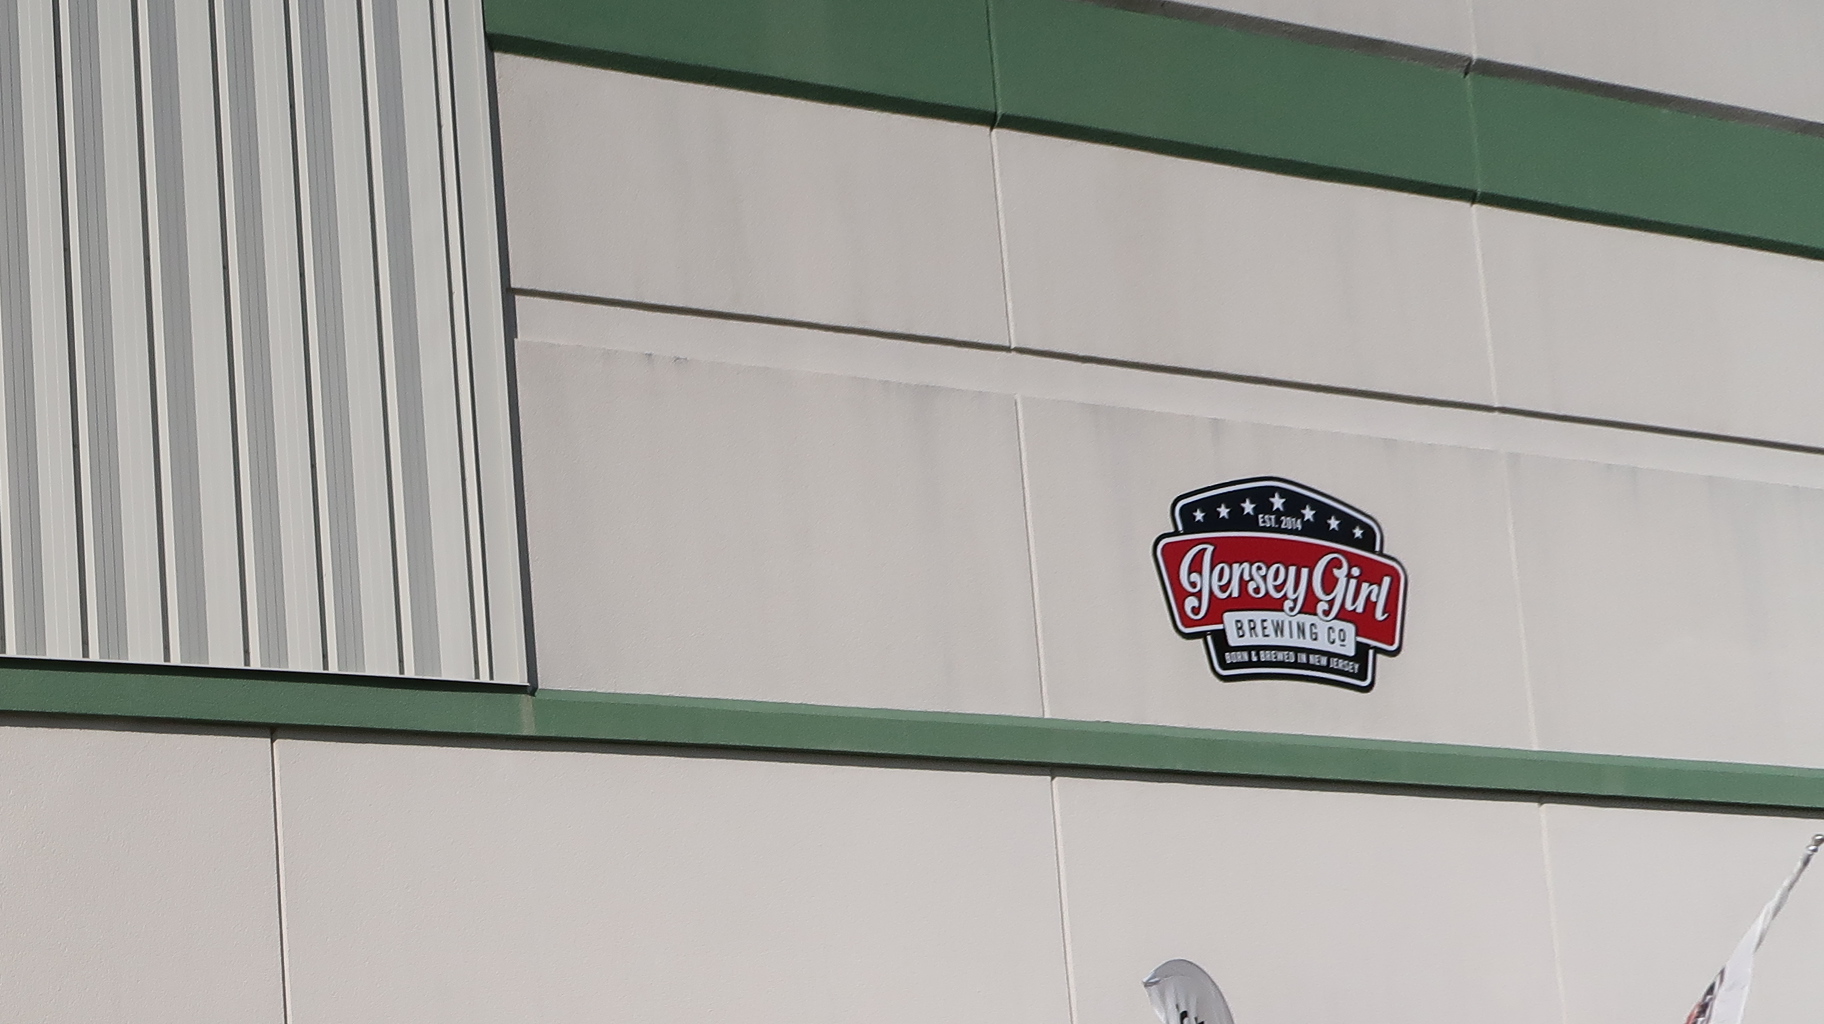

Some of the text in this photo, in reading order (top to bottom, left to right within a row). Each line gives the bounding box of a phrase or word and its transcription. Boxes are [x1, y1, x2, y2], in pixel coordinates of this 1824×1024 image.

[1258, 514, 1303, 531] EST. 2014
[1179, 543, 1392, 621] Jersey Girl
[1234, 618, 1319, 642] BREWING
[1224, 650, 1360, 674] BORN & BREWED IN NEW JERSEY
